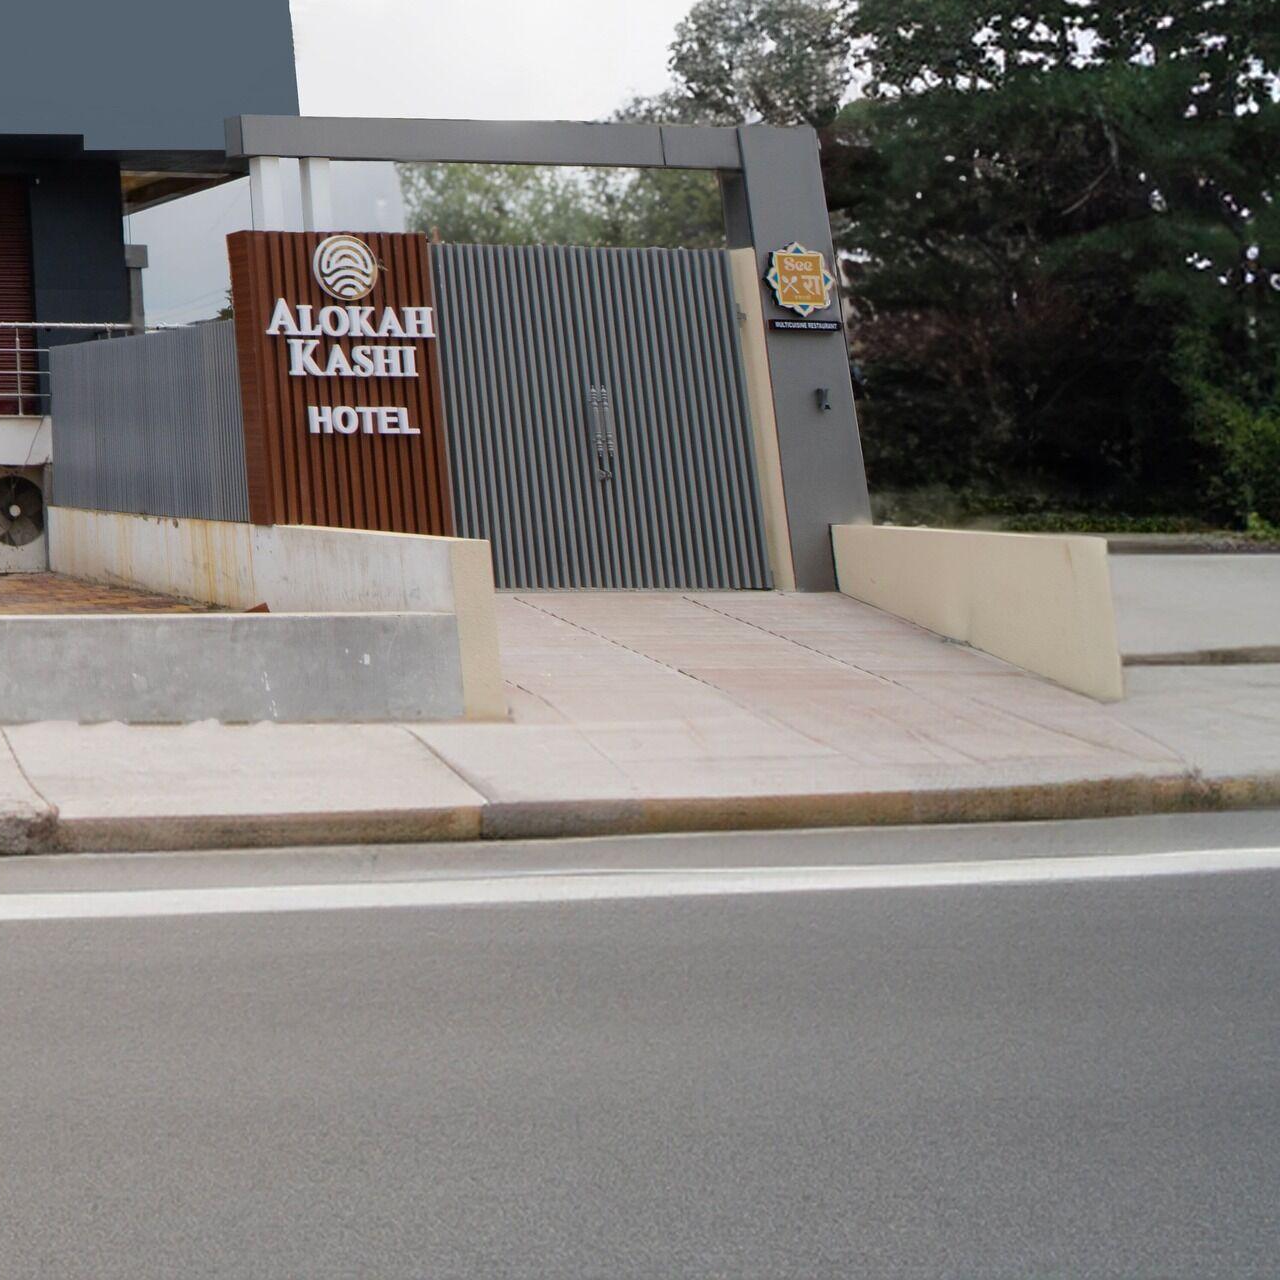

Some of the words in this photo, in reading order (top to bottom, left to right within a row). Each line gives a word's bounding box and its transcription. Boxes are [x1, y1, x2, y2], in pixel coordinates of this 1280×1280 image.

[783, 257, 814, 271] See
[265, 297, 436, 338] ALOKAH
[287, 338, 419, 378] KASHI
[308, 406, 421, 434] HOTEL
